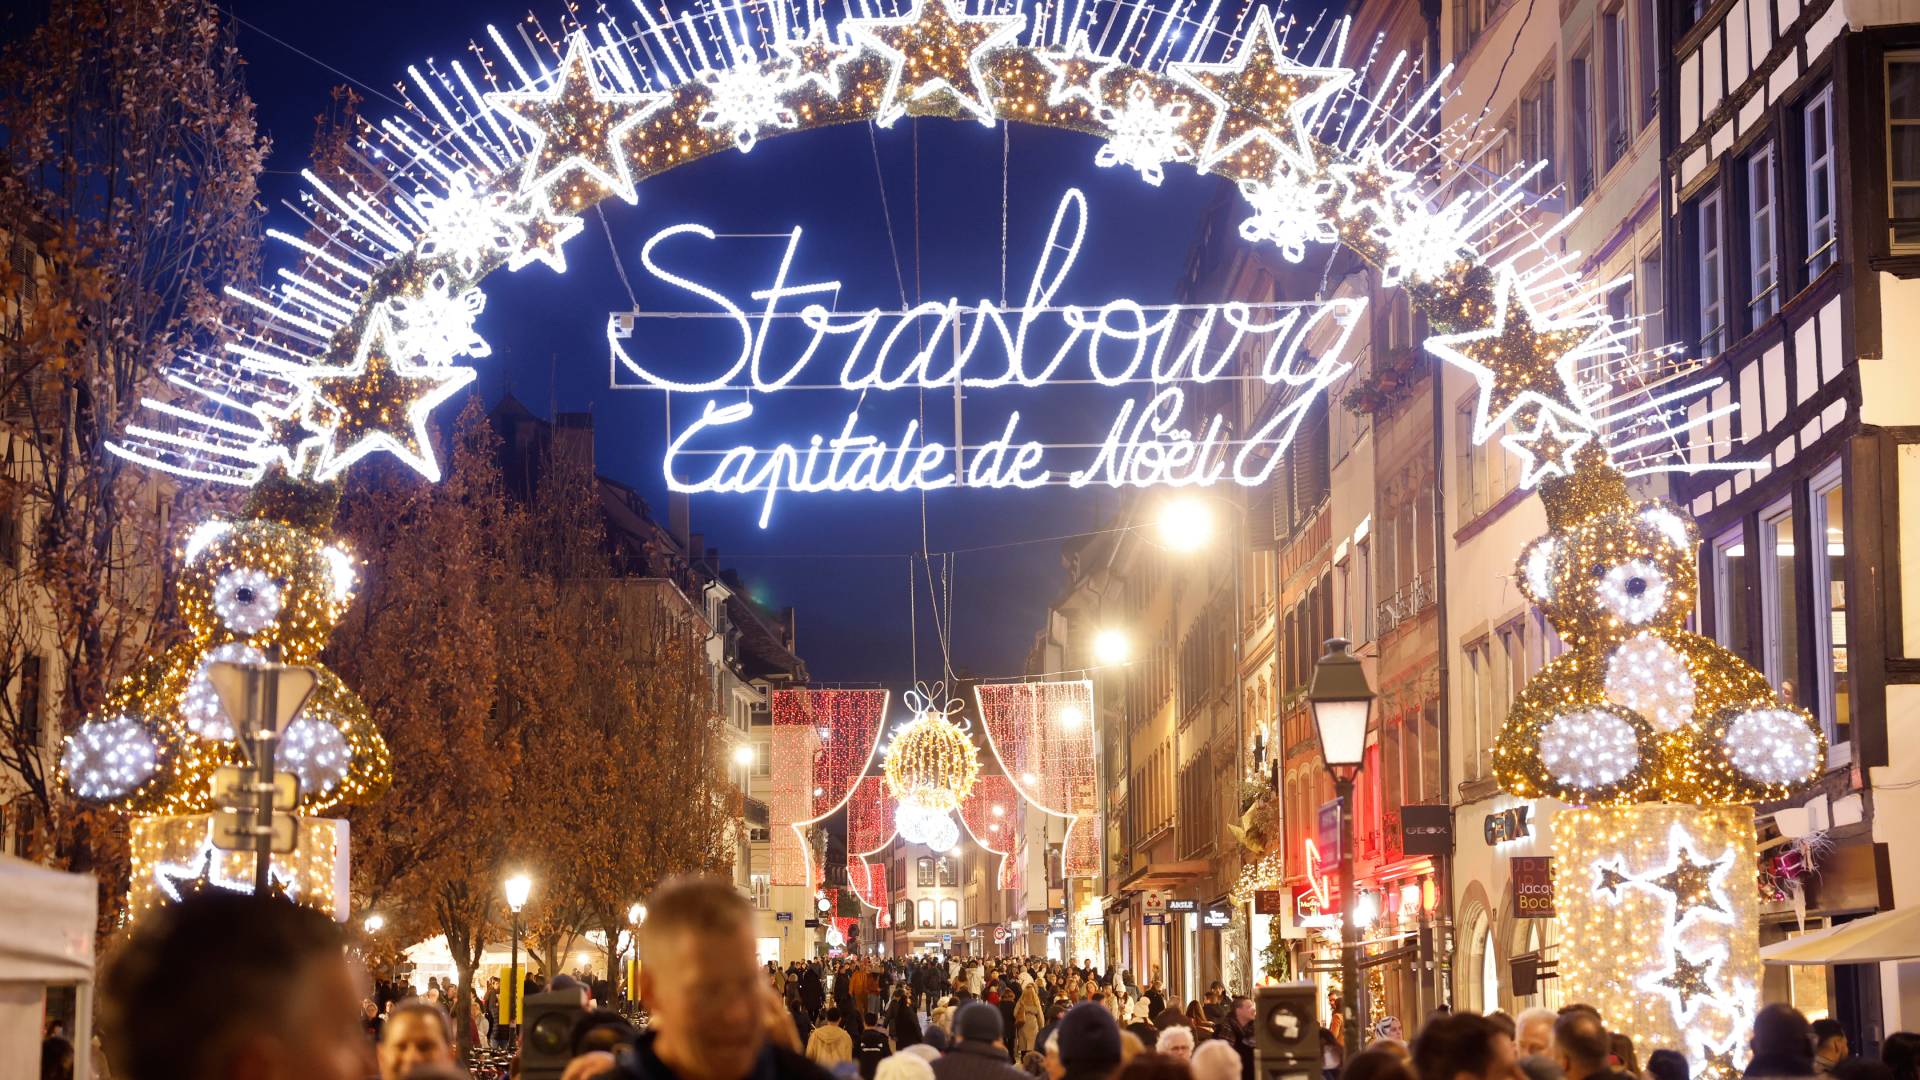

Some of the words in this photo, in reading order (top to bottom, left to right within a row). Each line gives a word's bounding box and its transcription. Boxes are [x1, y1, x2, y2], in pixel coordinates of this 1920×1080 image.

[607, 188, 1369, 488] Strasbourg
[663, 400, 956, 529] Capitale
[968, 411, 1049, 488] de
[1069, 386, 1223, 488] Noël
